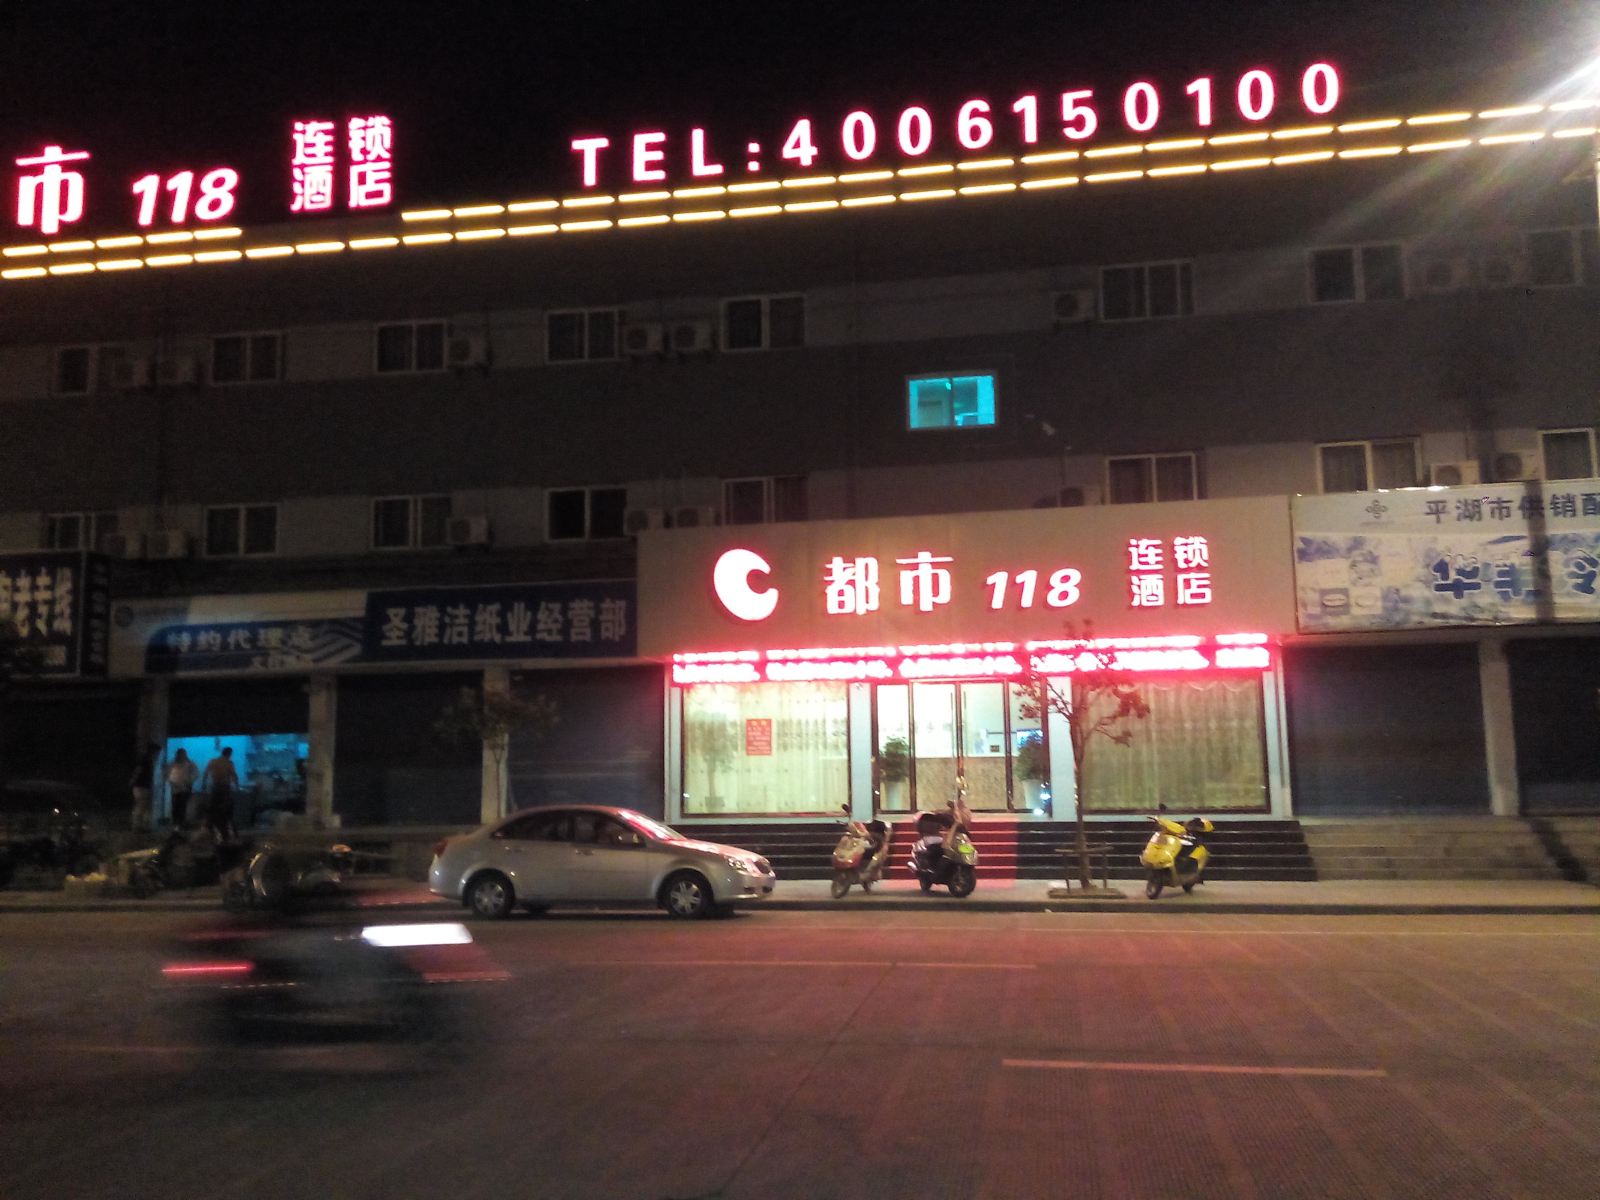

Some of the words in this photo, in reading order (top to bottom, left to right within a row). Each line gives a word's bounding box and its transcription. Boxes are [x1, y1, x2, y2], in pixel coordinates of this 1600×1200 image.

[15, 146, 89, 234] 市
[132, 168, 238, 226] 118
[823, 550, 955, 616] 都市
[984, 567, 1083, 610] 118
[380, 598, 627, 647] 圣雅洁纸业经营部
